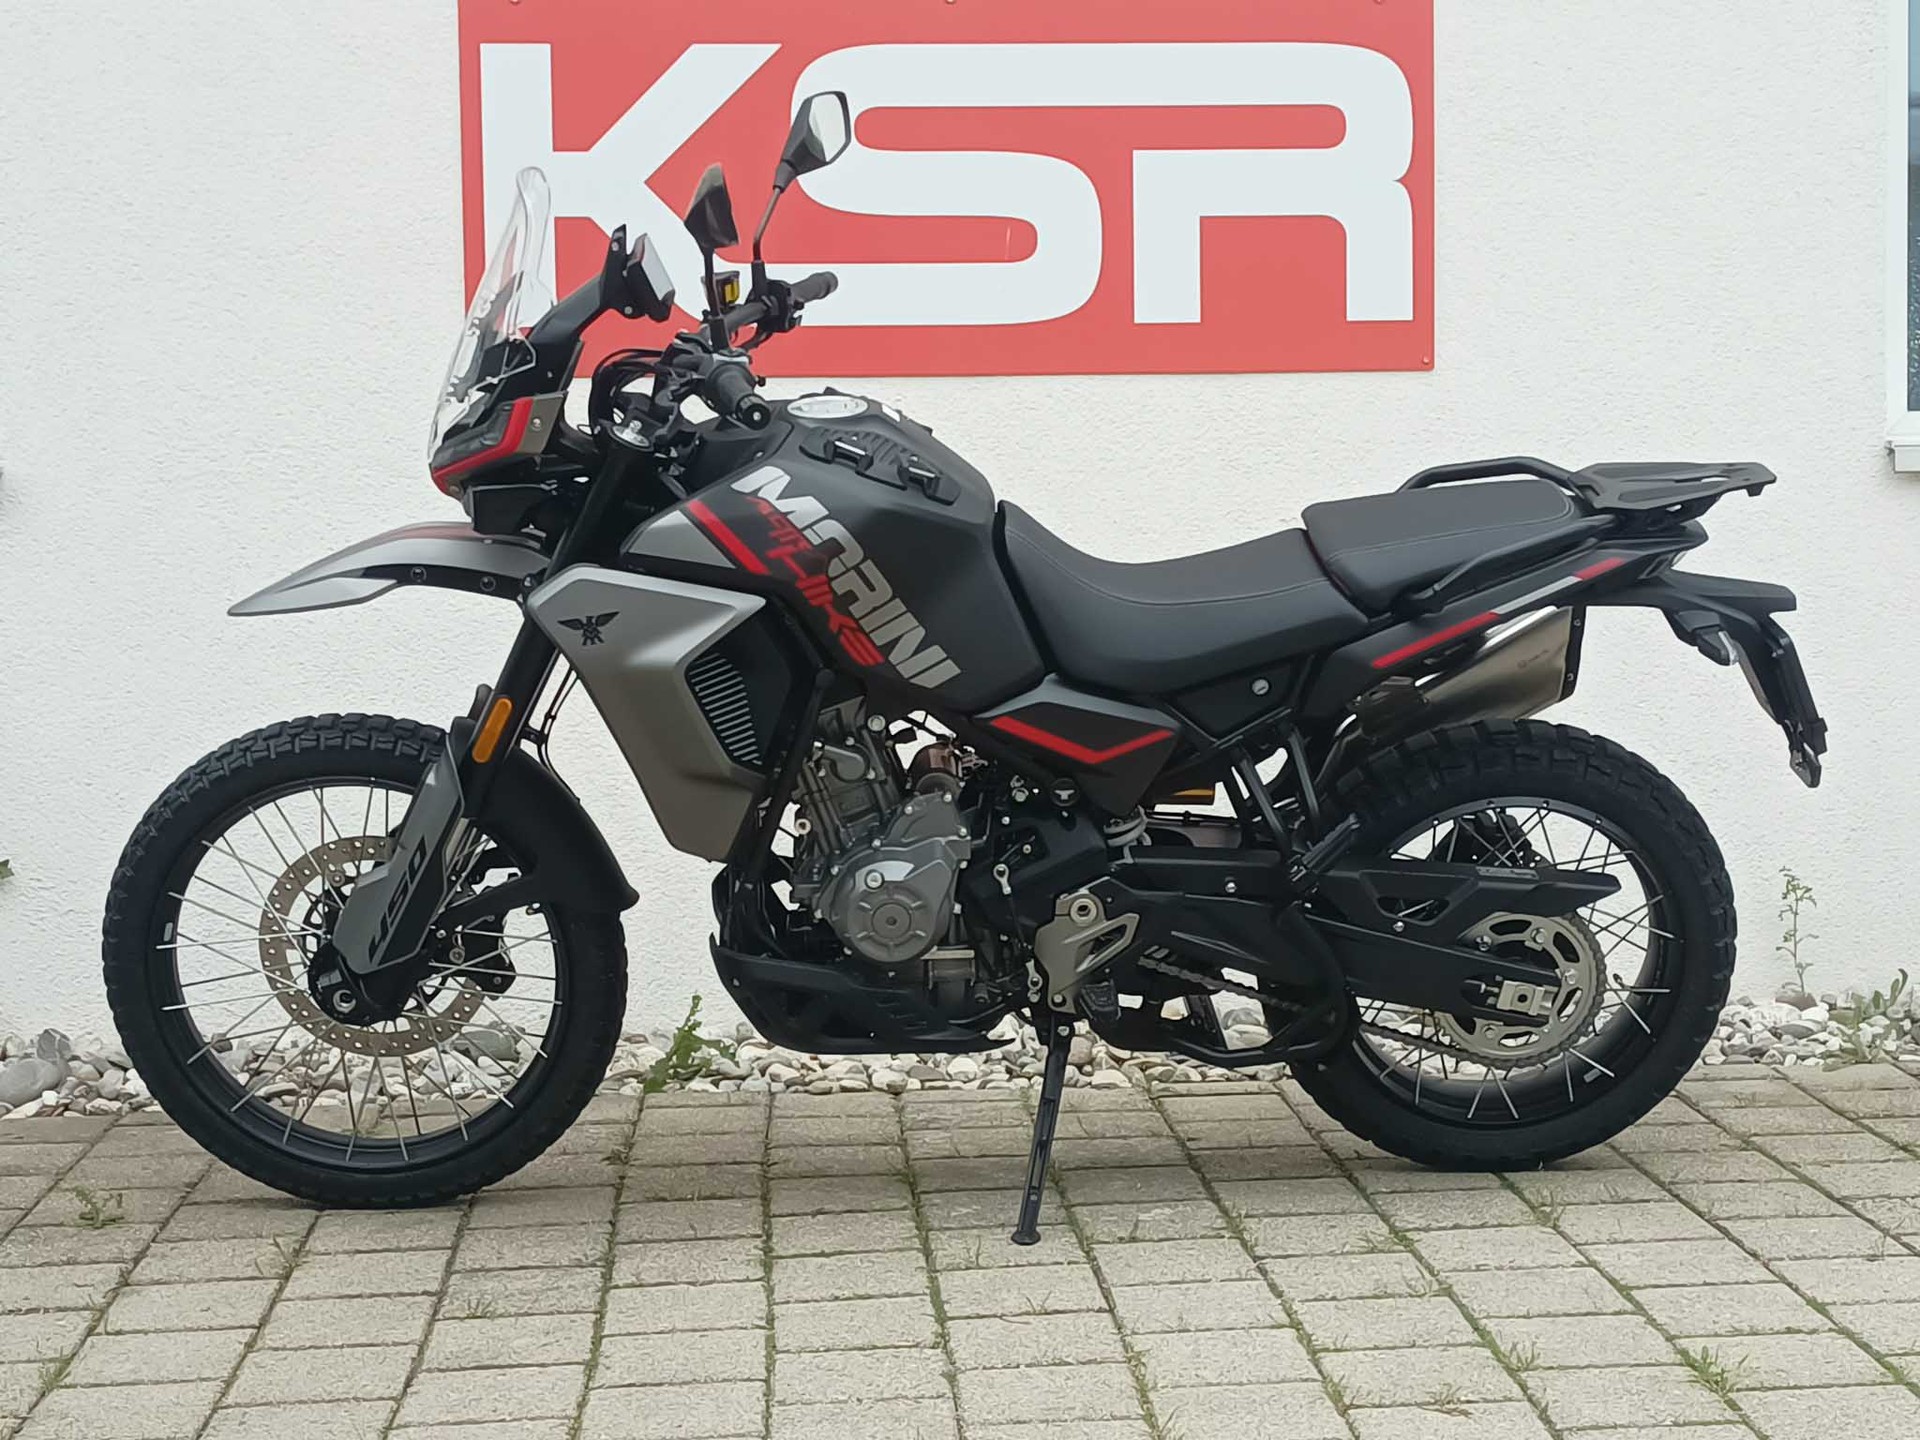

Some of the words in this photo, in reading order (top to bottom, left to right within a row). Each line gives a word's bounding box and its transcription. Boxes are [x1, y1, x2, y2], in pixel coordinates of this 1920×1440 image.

[480, 42, 1415, 328] KSR
[730, 465, 961, 689] MORINI
[368, 835, 428, 964] 450
